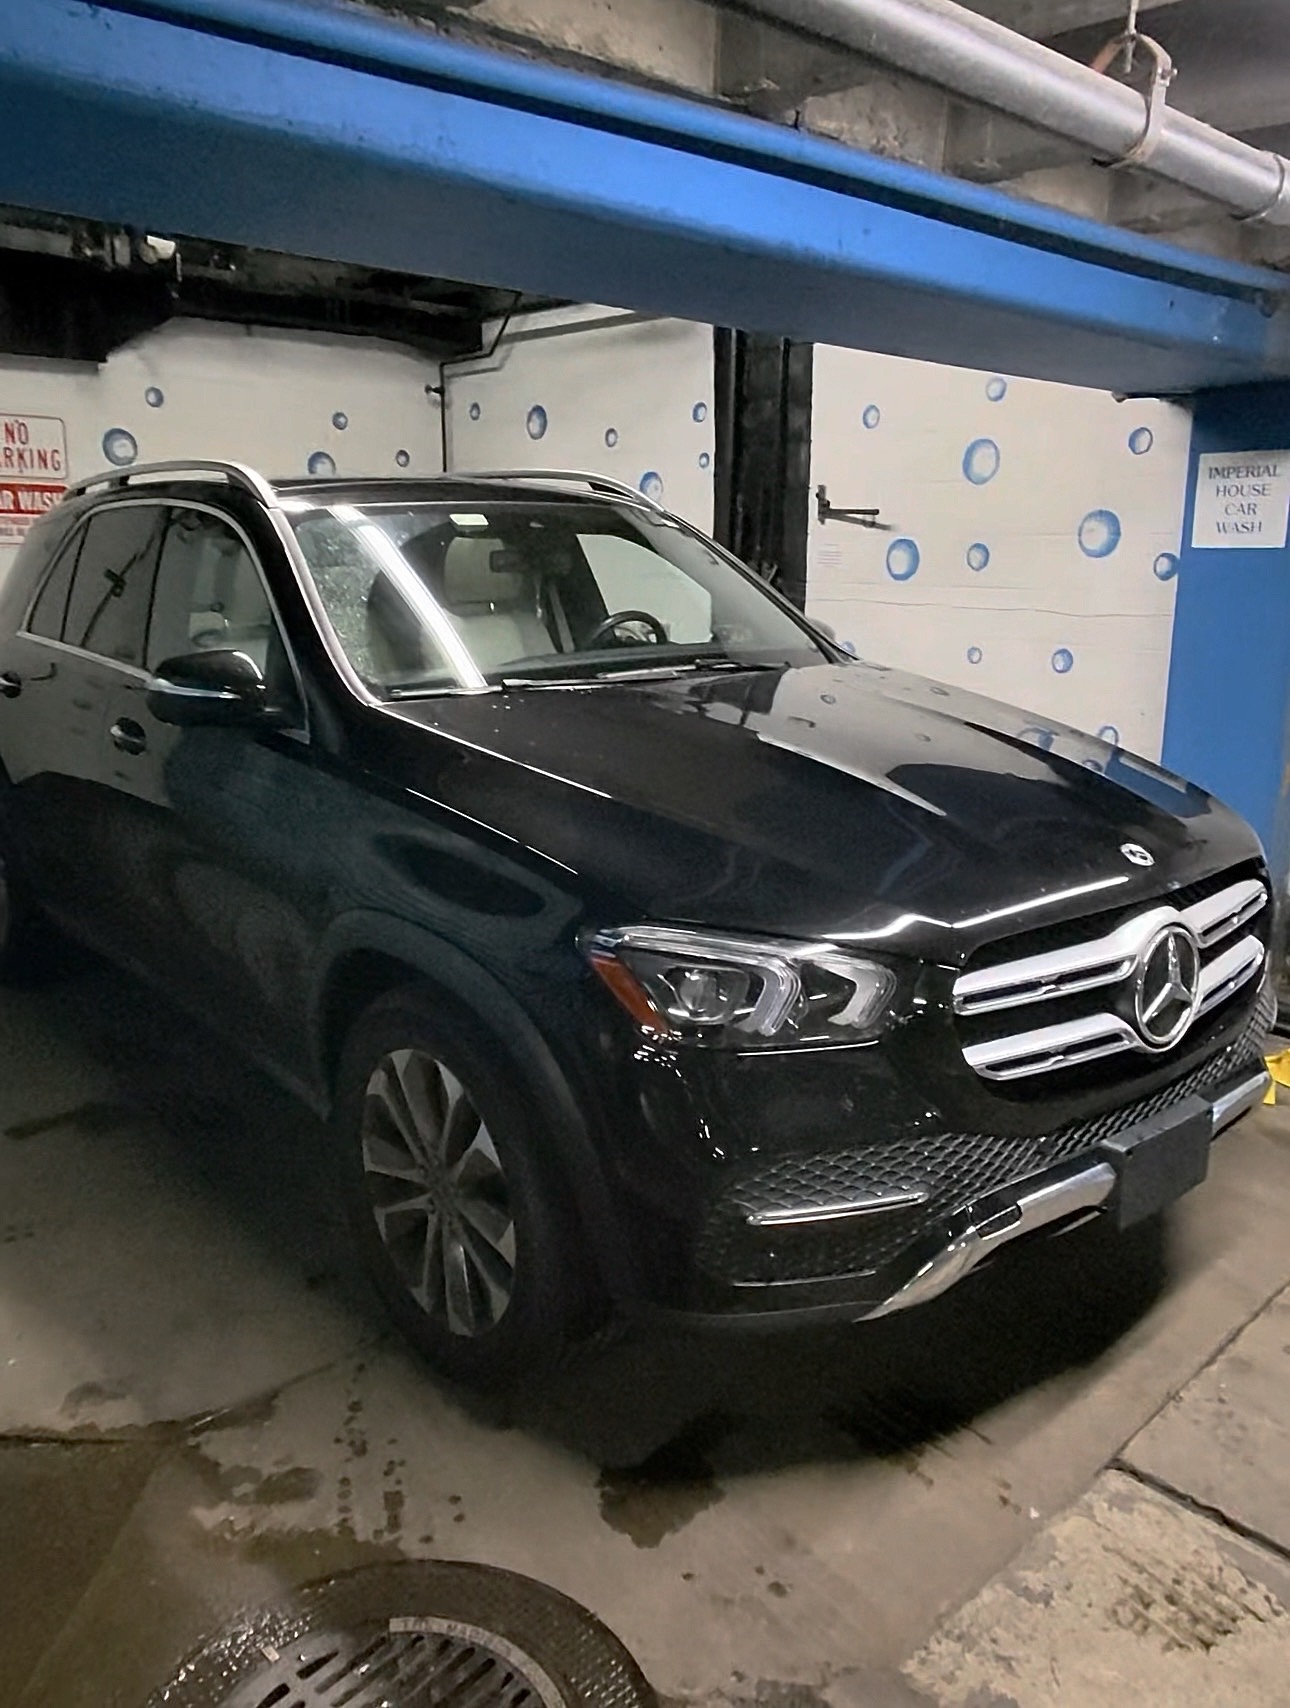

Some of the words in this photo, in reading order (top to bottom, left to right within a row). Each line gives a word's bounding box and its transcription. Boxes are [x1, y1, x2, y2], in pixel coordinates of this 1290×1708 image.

[5, 422, 29, 445] NO
[0, 447, 61, 471] RKING
[1208, 464, 1279, 479] IMPERIAL
[1216, 483, 1272, 498] HOUSE
[1225, 502, 1258, 516] CAR
[1216, 521, 1262, 534] WASH
